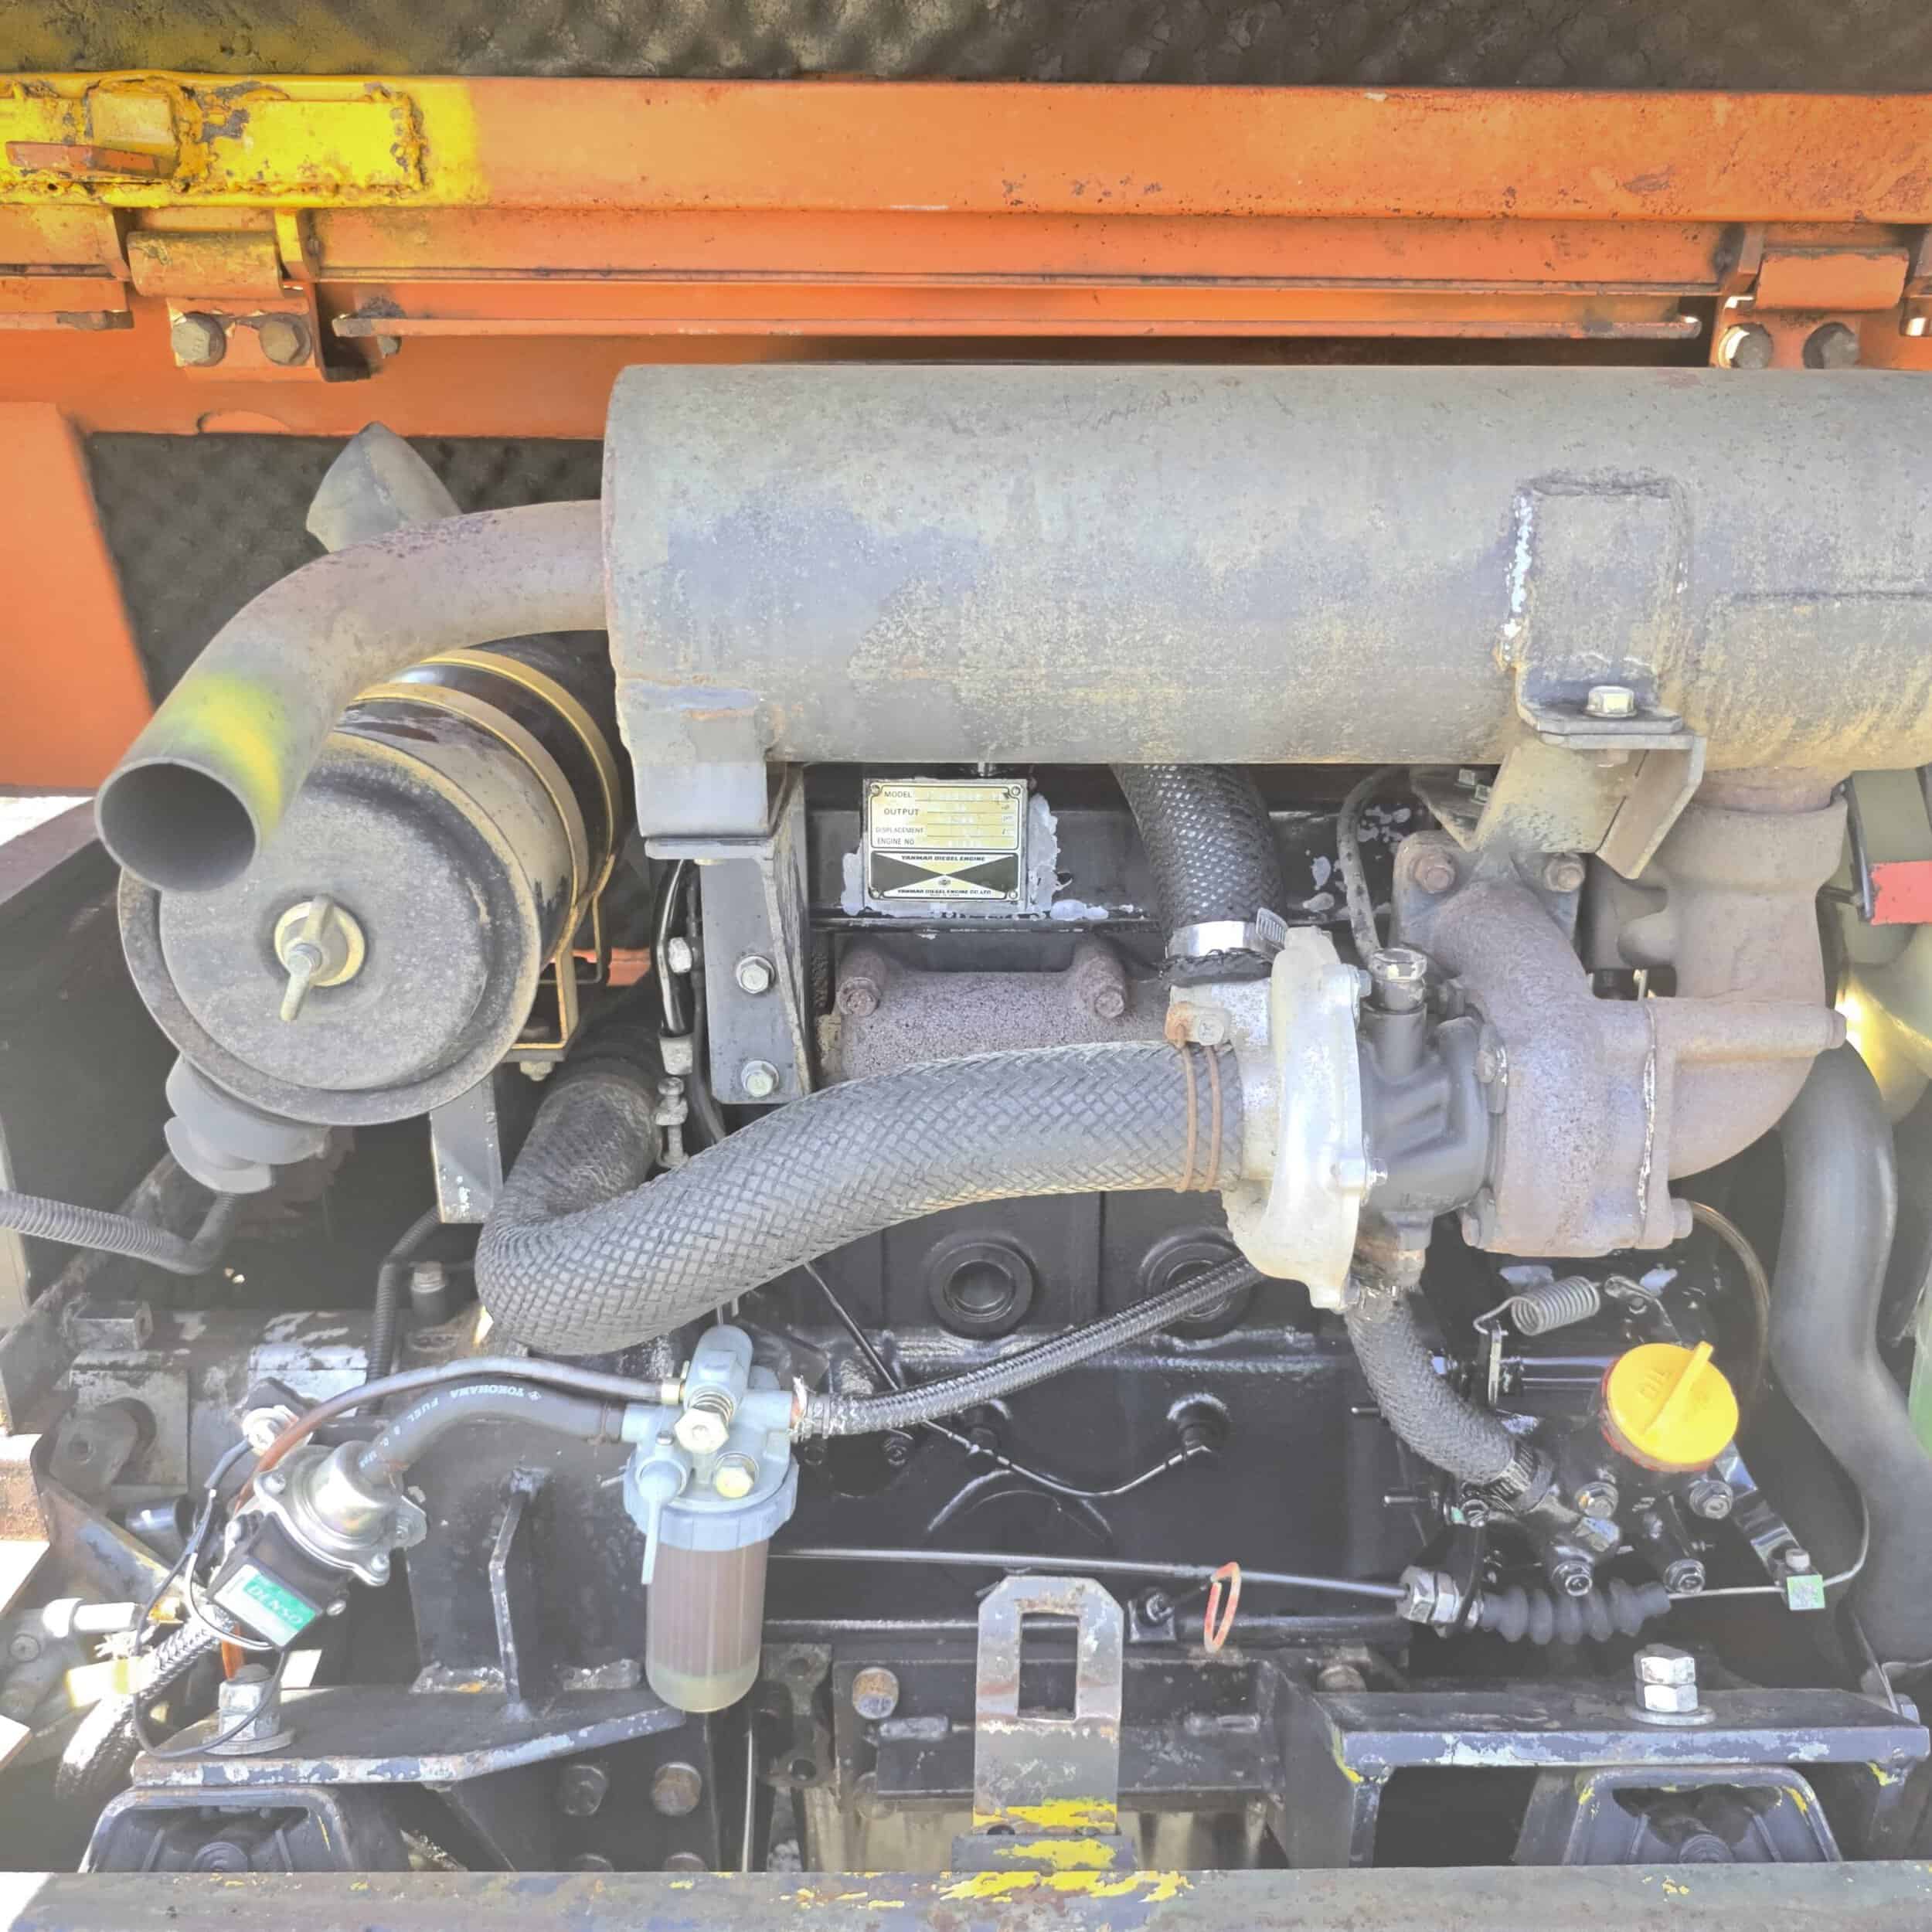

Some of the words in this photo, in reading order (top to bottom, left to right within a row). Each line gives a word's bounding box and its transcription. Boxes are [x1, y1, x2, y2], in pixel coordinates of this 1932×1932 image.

[884, 790, 913, 798] MODEL
[451, 1384, 525, 1399] YOKOHAMA
[1638, 1367, 1674, 1399] OIL
[406, 1397, 439, 1422] FUEL
